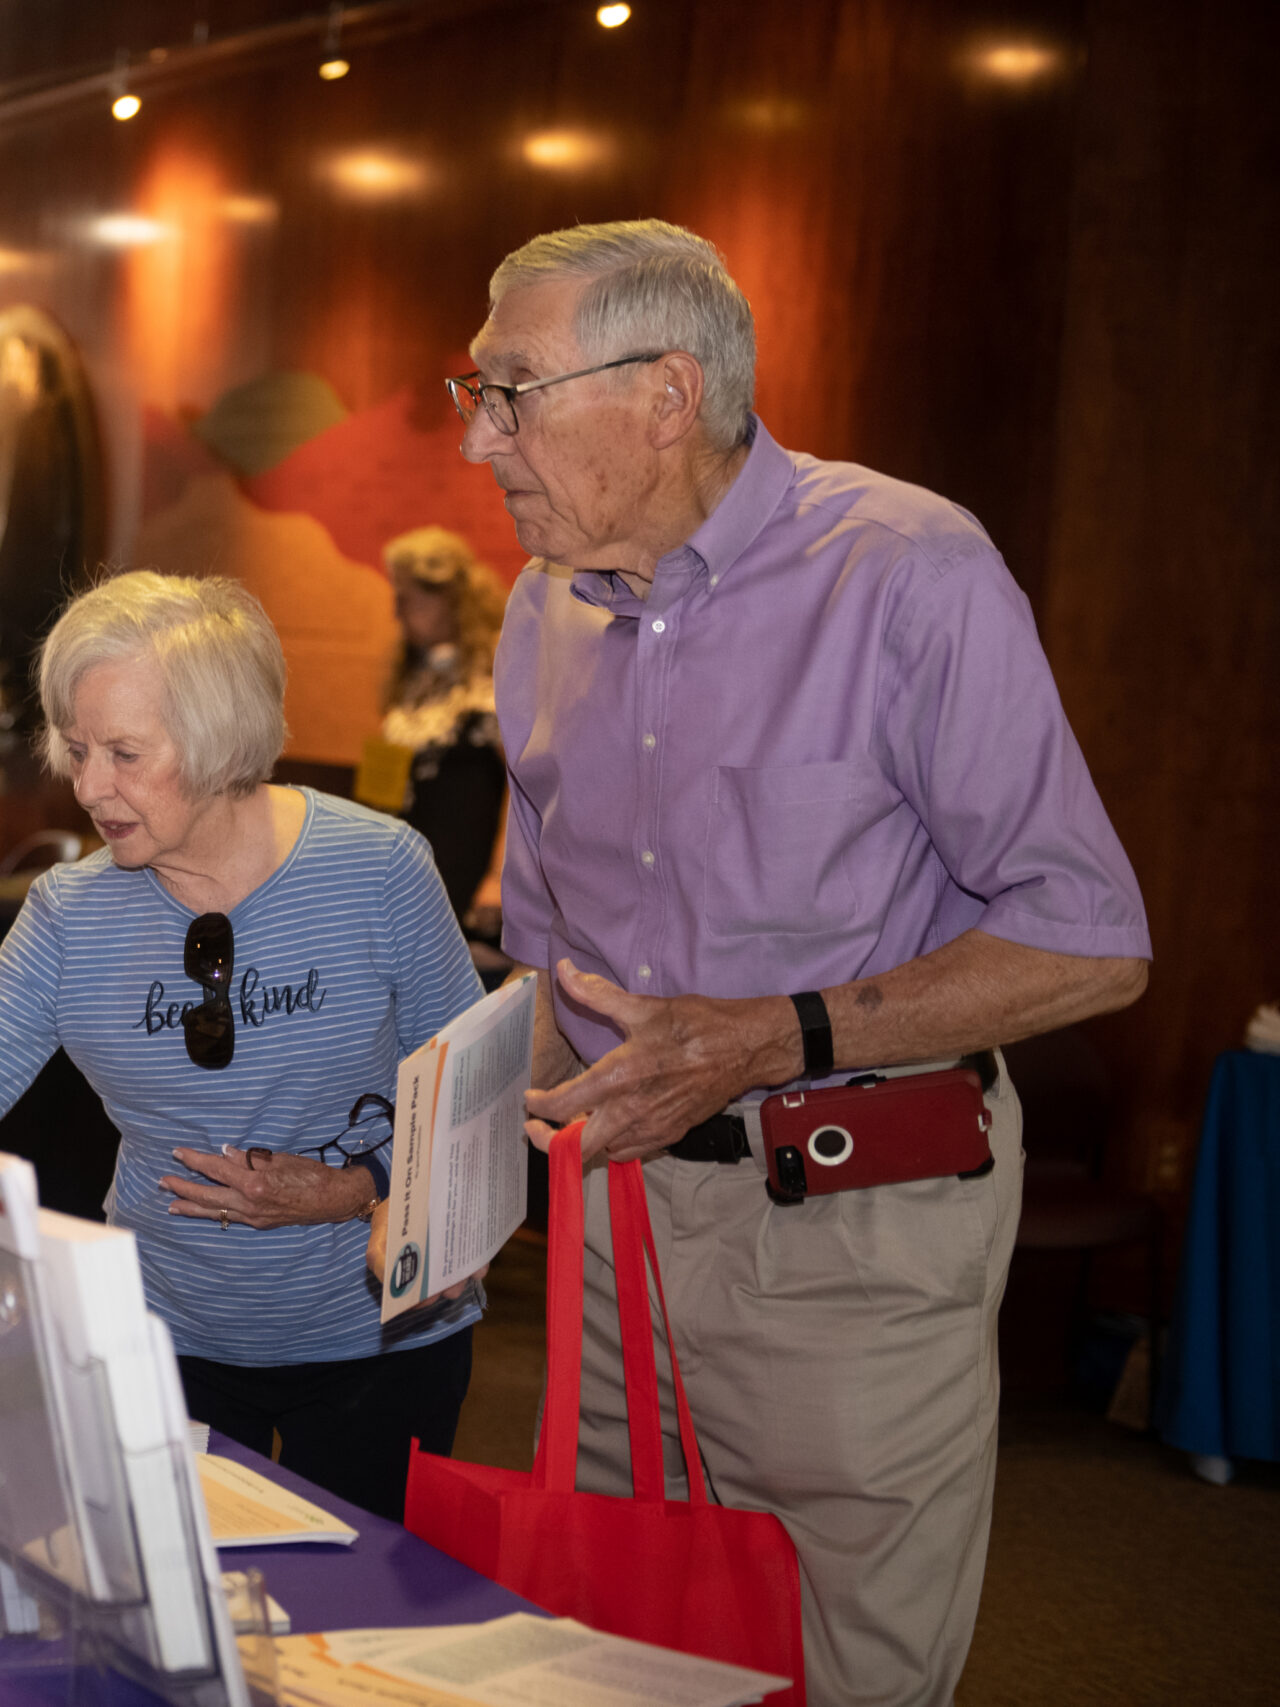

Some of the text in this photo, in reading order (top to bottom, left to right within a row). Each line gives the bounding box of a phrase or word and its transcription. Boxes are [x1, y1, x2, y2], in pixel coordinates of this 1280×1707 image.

[240, 967, 327, 1027] kind
[410, 1075, 420, 1110] Pack
[406, 1112, 417, 1165] Sample
[405, 1167, 413, 1188] On
[402, 1204, 410, 1237] Pass
